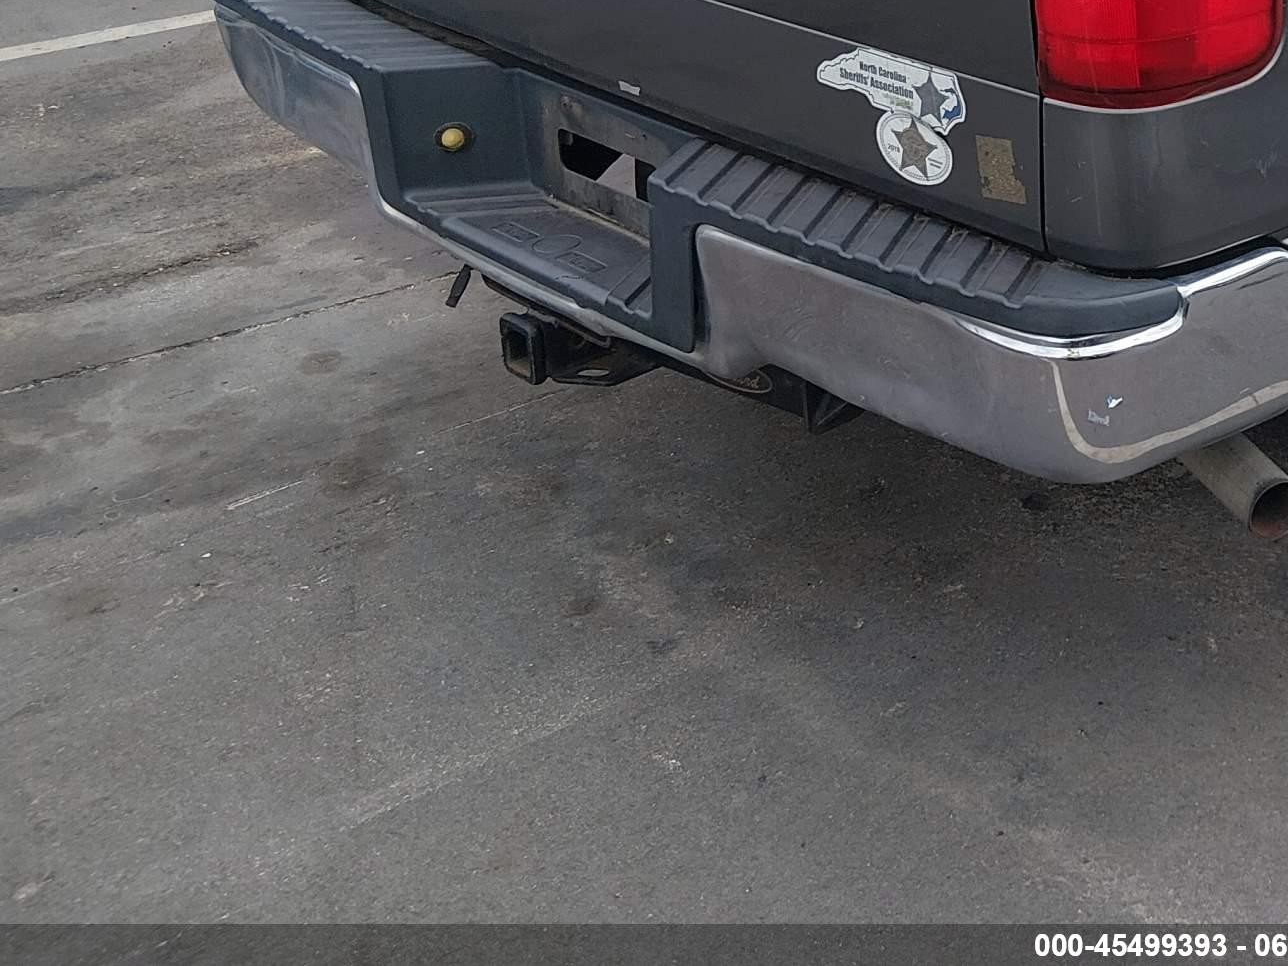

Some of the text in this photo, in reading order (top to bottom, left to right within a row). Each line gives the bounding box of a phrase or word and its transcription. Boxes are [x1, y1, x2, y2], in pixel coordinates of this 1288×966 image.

[859, 61, 907, 83] North Carolina
[870, 76, 914, 99] Association
